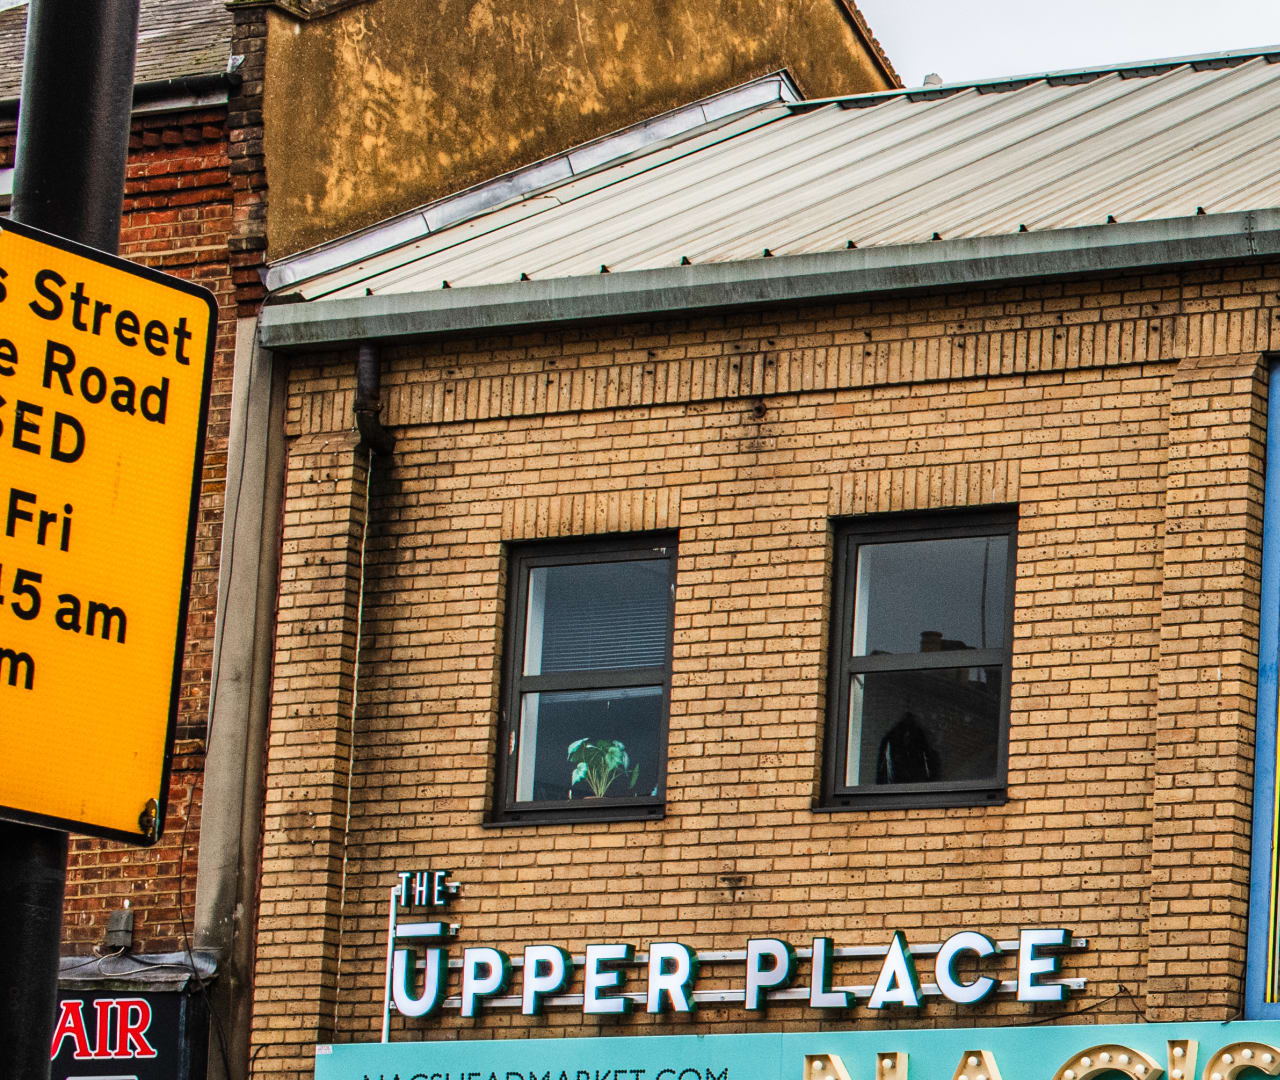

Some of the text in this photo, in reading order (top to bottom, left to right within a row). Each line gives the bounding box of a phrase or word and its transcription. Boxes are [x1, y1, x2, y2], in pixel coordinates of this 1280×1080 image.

[29, 268, 192, 366] Street
[42, 340, 169, 425] Road
[6, 490, 73, 554] Fri
[55, 590, 127, 645] am
[398, 870, 449, 908] THE
[392, 926, 1074, 1018] UPPER PLACE
